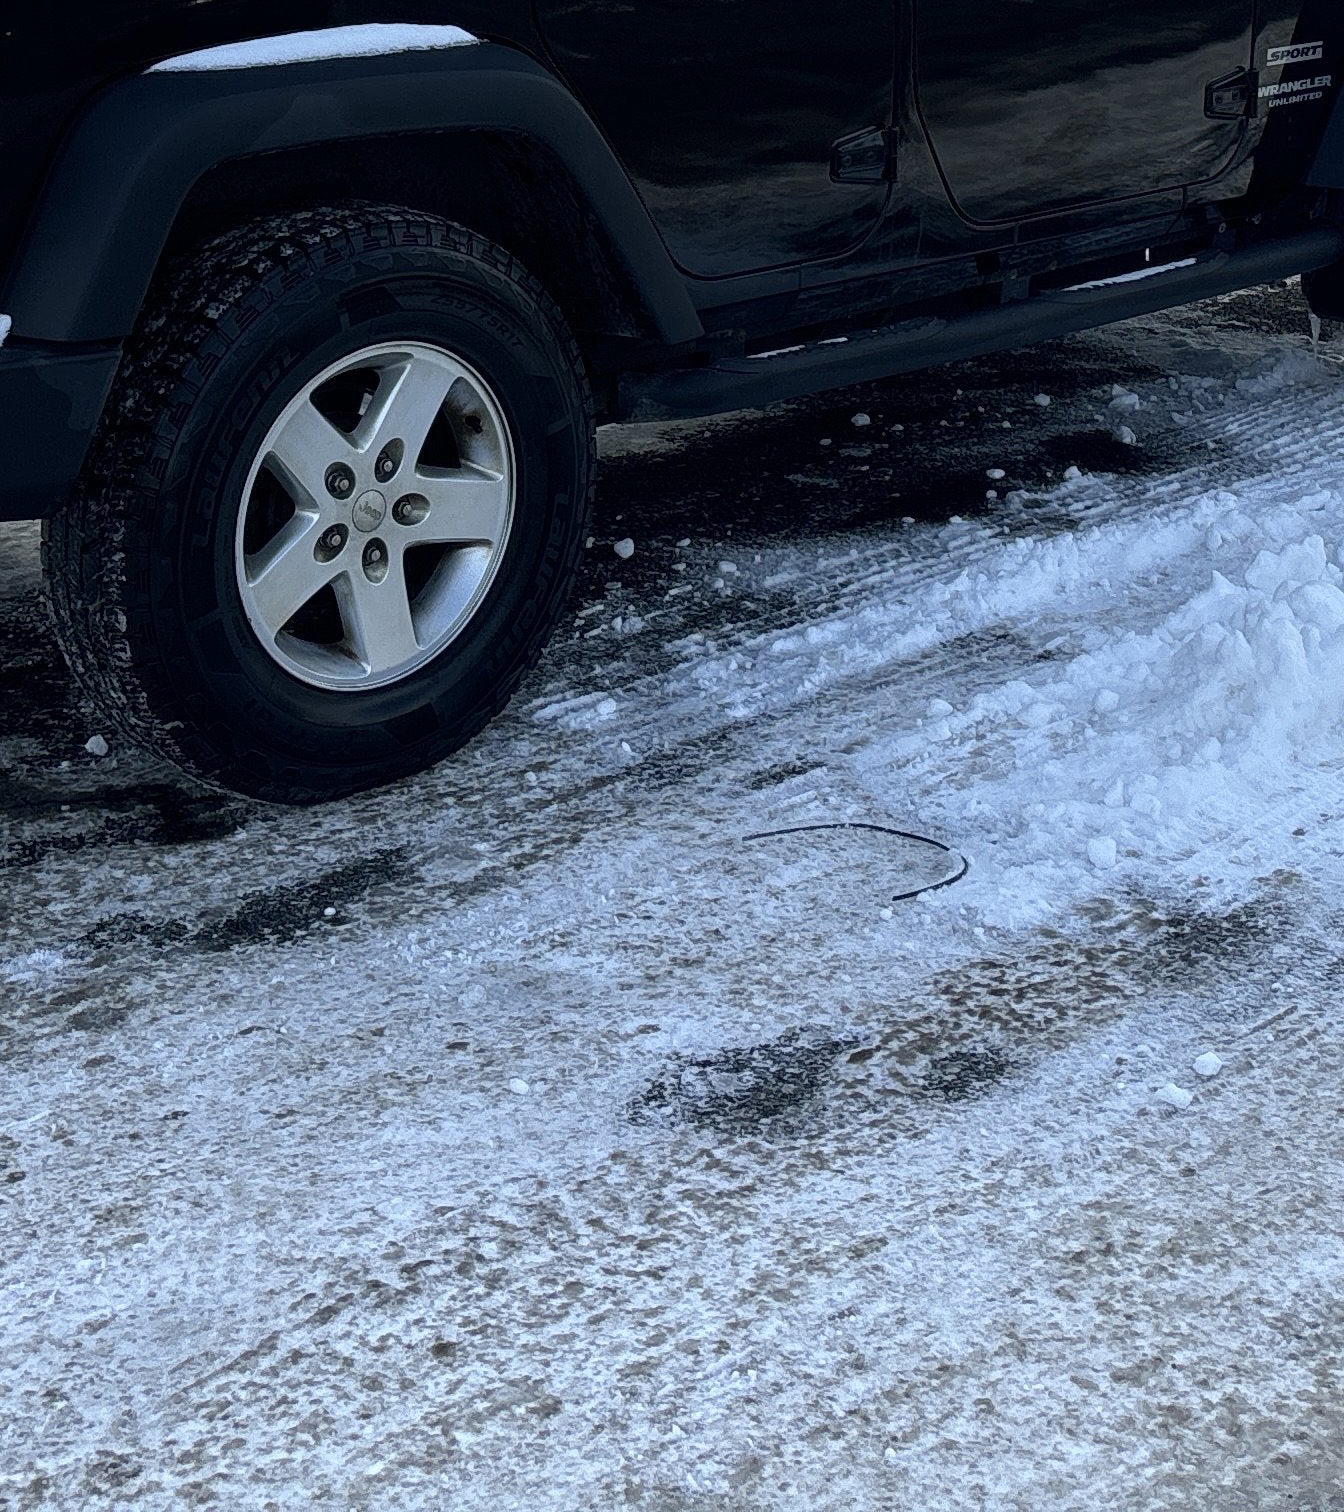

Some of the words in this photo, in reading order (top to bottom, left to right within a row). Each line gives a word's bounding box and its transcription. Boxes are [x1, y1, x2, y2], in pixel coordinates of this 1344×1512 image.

[1267, 45, 1322, 63] SPORT
[1257, 75, 1332, 98] WRANGLER
[1268, 91, 1323, 108] UNLIMITED
[358, 500, 382, 521] Jeep
